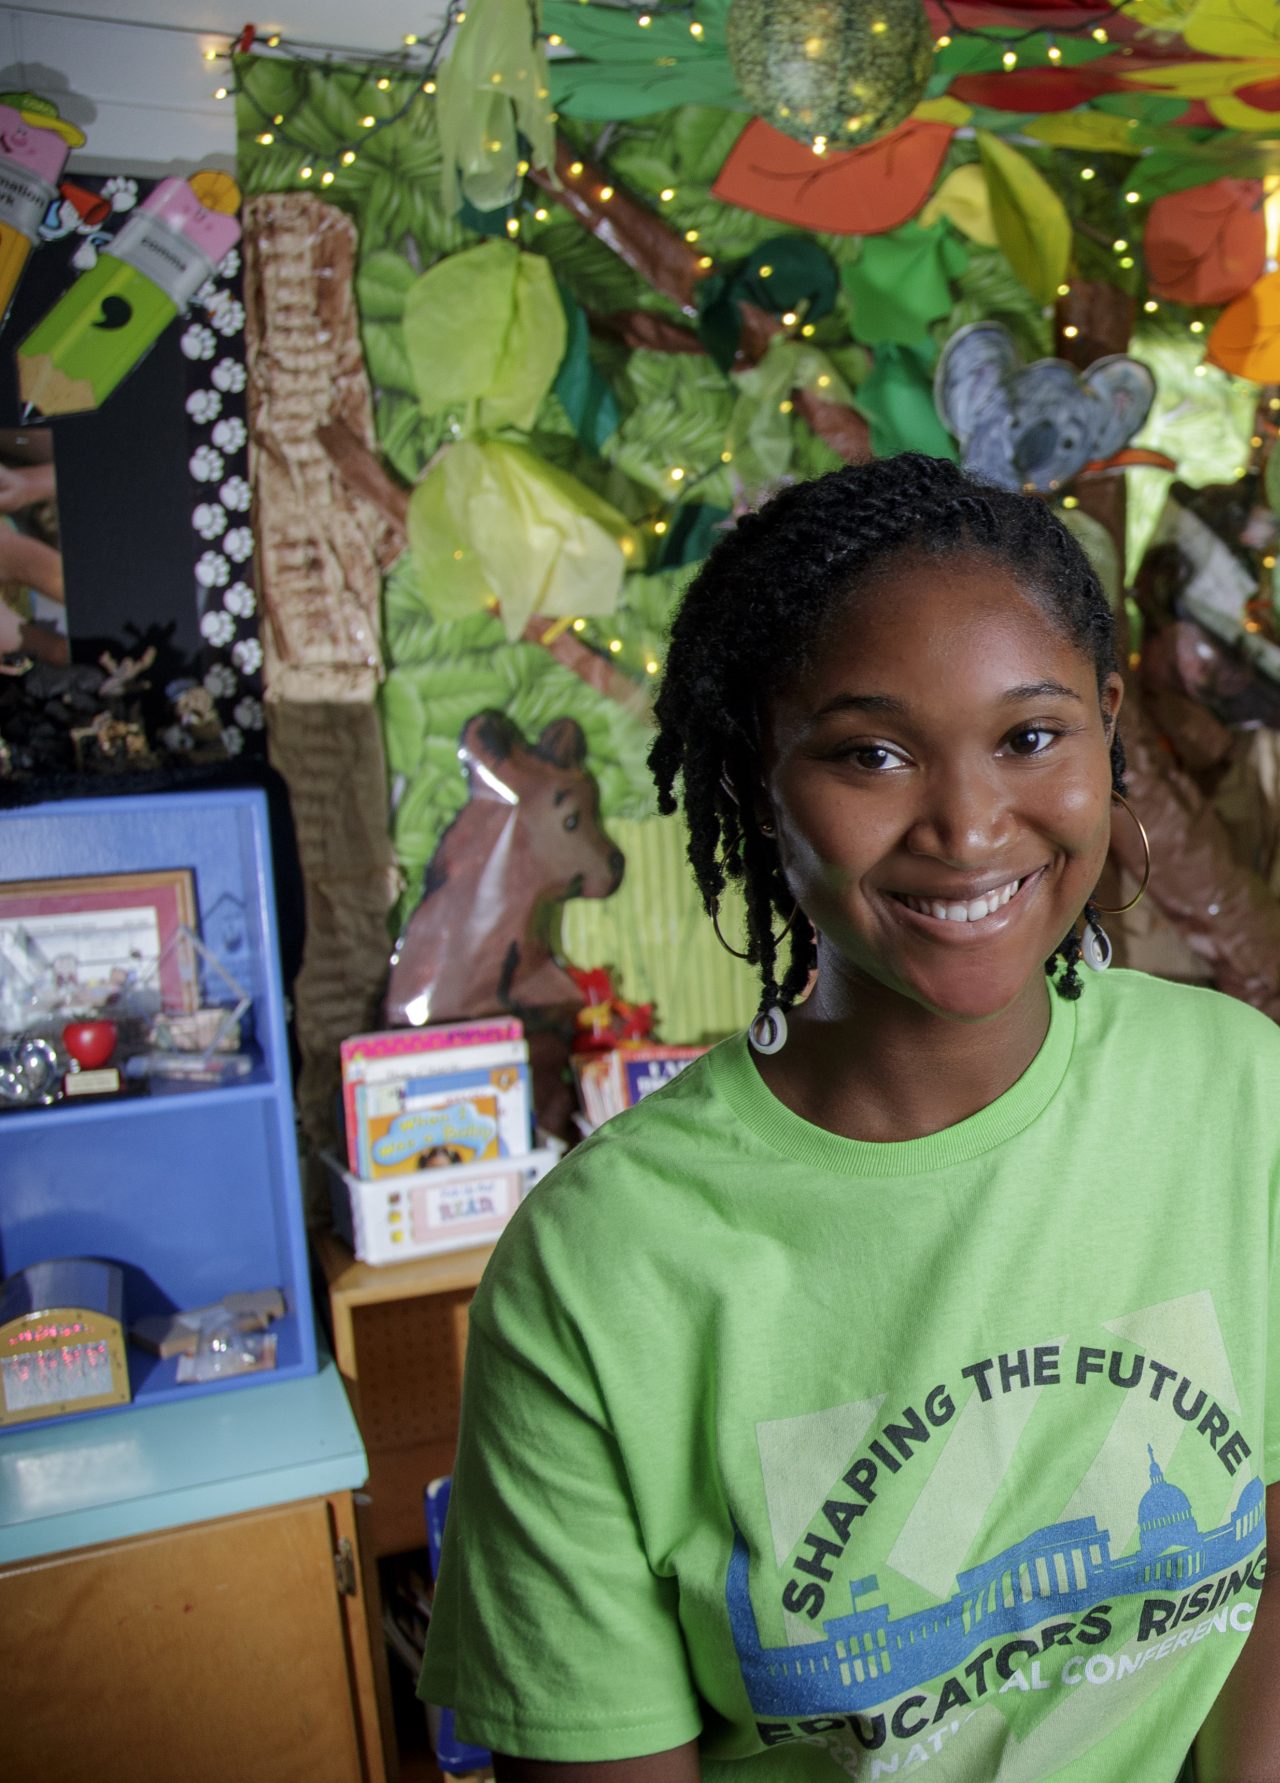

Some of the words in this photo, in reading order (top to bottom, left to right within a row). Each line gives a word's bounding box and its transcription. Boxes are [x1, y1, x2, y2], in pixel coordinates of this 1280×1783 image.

[782, 1384, 957, 1620] SHAPING
[961, 1345, 1060, 1403] THE
[1075, 1346, 1251, 1477] FUTURE
[756, 1604, 1112, 1751] EDUCATORS
[1137, 1547, 1266, 1642] RISING
[1061, 1601, 1254, 1685] CONFERENC
